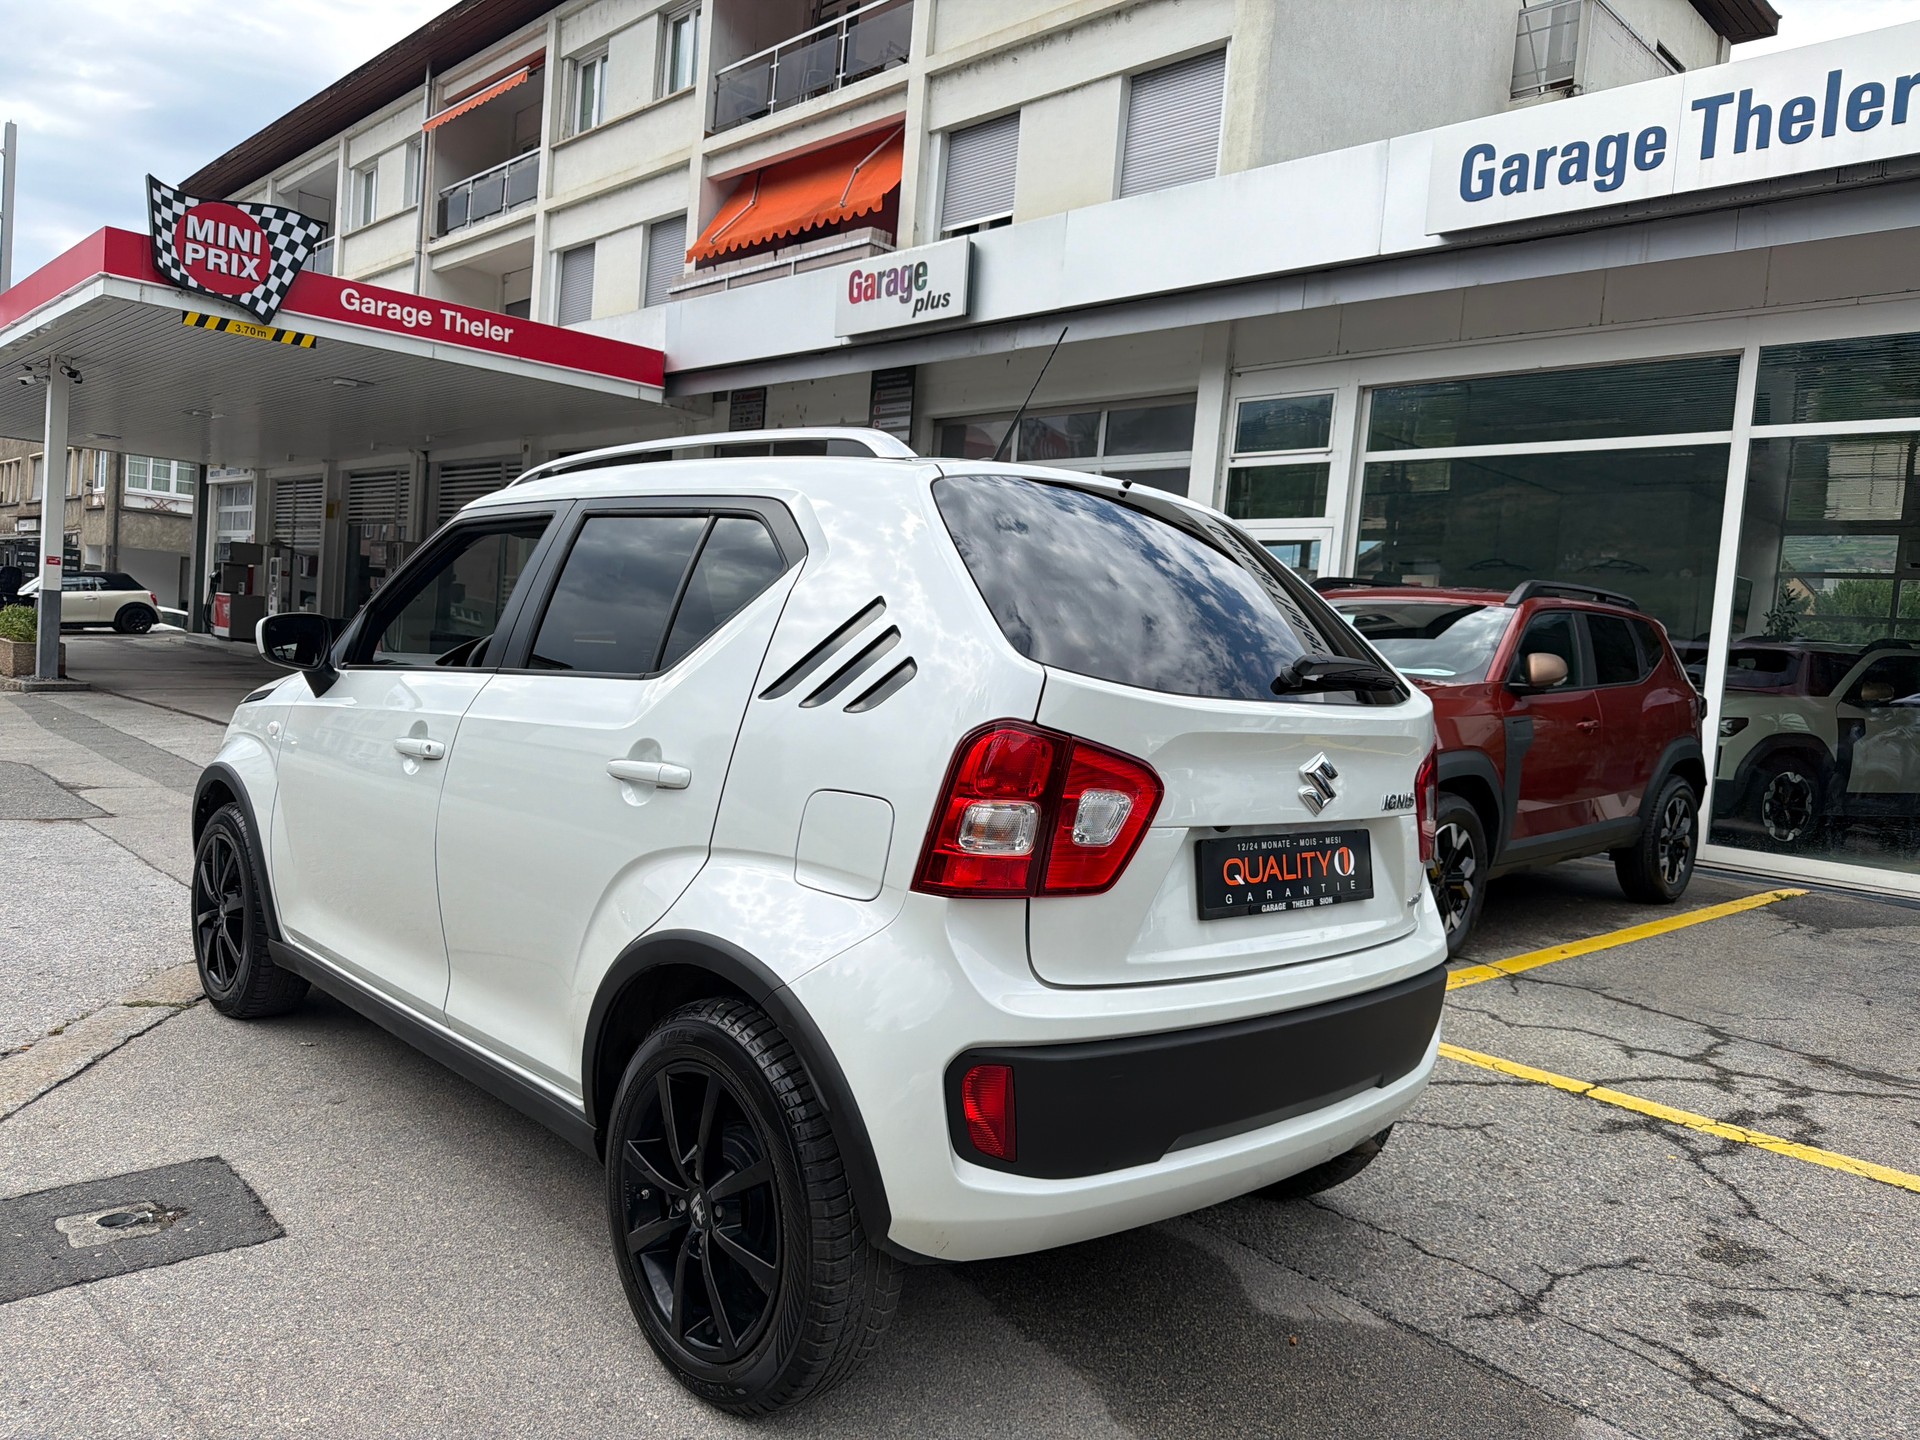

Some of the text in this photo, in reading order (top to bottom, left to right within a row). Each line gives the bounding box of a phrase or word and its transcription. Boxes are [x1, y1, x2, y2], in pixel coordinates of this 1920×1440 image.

[1460, 69, 1920, 202] Garage Theler
[186, 214, 262, 255] MINI
[184, 242, 261, 282] PRIX
[848, 261, 928, 304] Garage
[340, 288, 514, 342] Garage Theler
[912, 291, 951, 318] plus
[1381, 793, 1414, 811] IGNIS
[1237, 841, 1258, 851] 12/24
[1261, 840, 1291, 850] MONATE
[1299, 838, 1317, 847] MOIS
[1325, 836, 1342, 845] MESI
[1225, 880, 1356, 904] GARANTIE
[1261, 896, 1333, 913] GARAGE THELER SION
